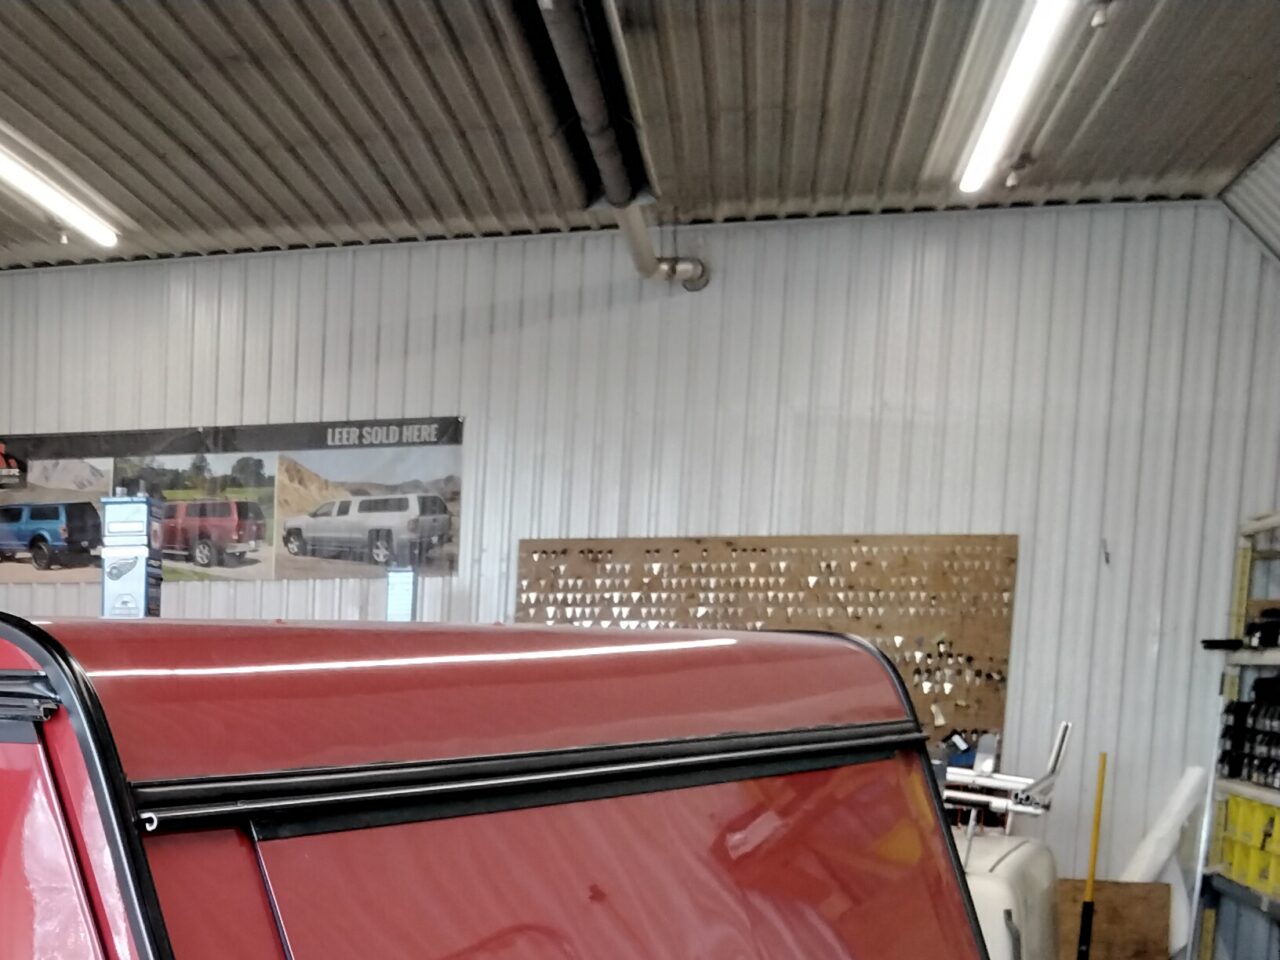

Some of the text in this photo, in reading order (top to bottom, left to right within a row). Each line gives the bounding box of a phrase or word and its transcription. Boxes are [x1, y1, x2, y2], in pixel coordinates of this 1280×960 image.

[327, 424, 439, 446] LEER SOLD HERE
